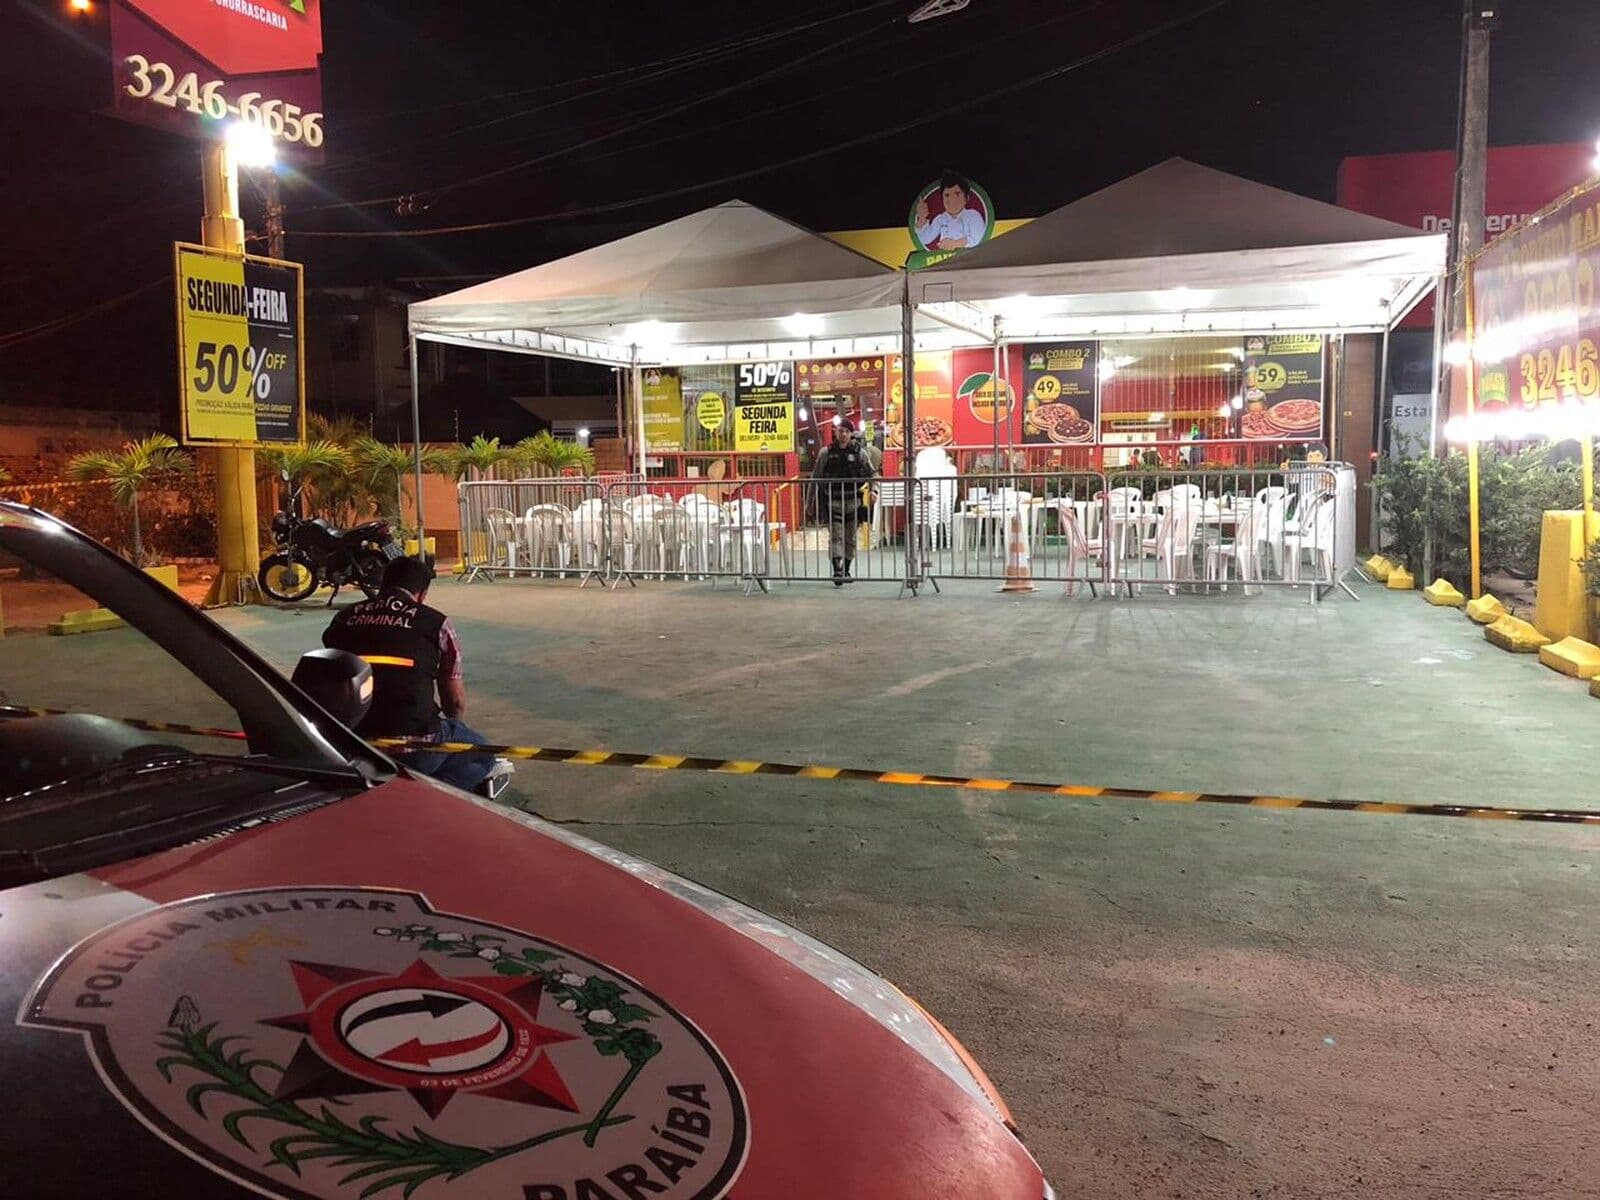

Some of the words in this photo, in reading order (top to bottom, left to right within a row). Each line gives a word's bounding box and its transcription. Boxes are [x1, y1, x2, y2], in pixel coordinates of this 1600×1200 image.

[124, 54, 324, 148] 3246-6656
[187, 277, 289, 324] SEGUNDA-FEIRA
[1046, 348, 1082, 359] COMBO
[193, 341, 271, 400] 50%
[265, 352, 287, 370] OFF
[740, 361, 790, 387] 50%
[1257, 368, 1278, 383] 59
[1037, 380, 1055, 393] 49
[741, 405, 787, 420] SEGUNDA
[1395, 405, 1431, 417] Esta
[750, 420, 777, 433] FEIRA
[346, 614, 413, 630] CRIMINAL
[205, 898, 397, 923] MILITAR
